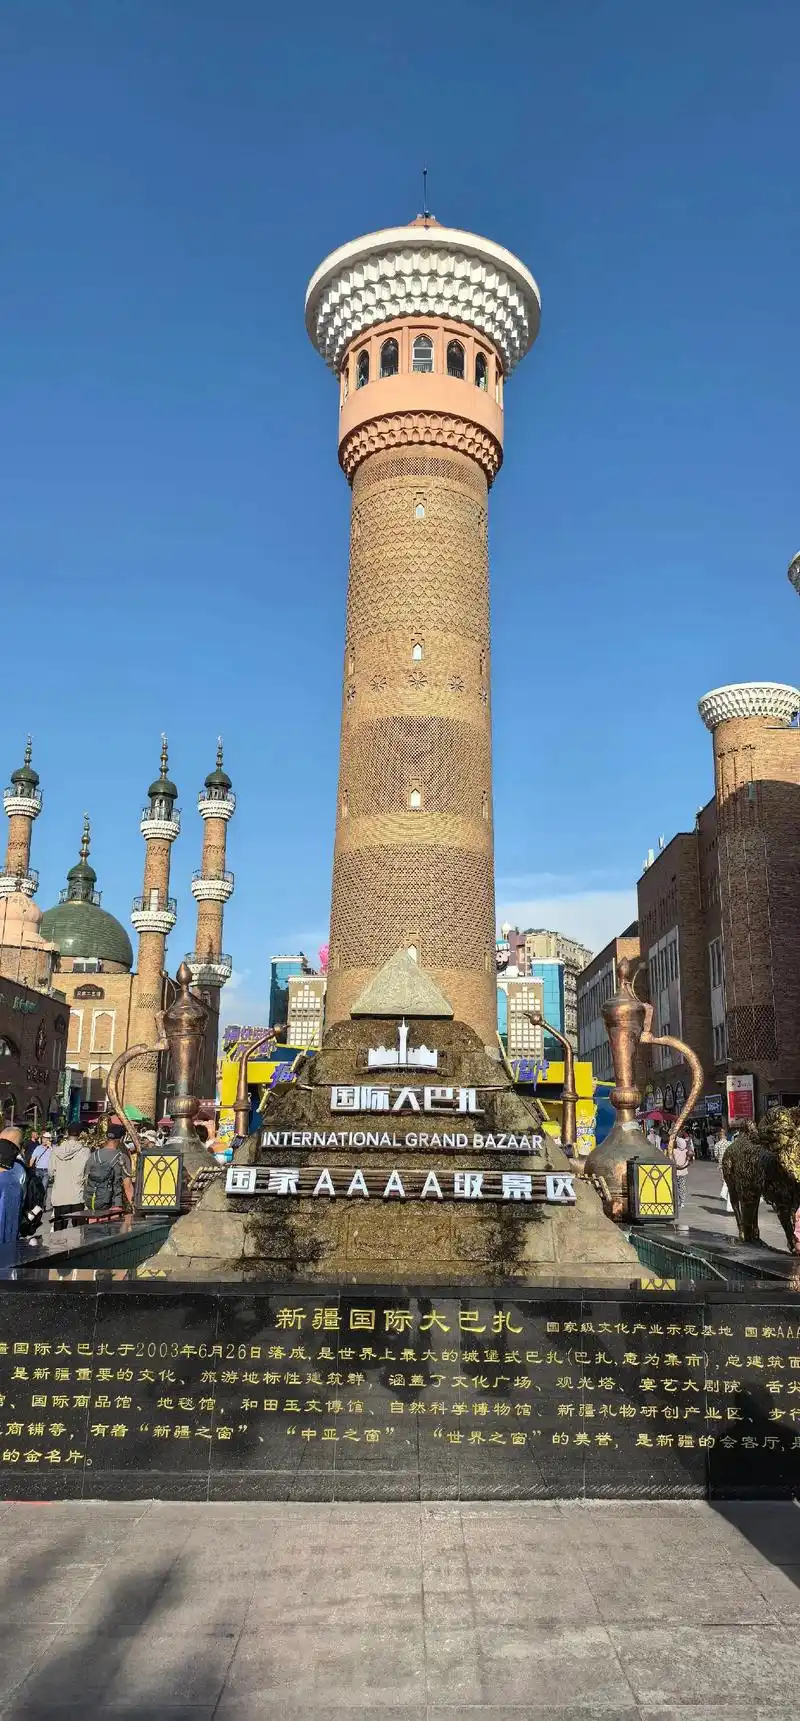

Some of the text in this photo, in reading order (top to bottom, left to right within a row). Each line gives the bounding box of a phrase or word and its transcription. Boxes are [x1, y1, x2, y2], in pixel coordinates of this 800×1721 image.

[330, 1086, 485, 1113] 国际大巴扎
[262, 1131, 544, 1150] INTERNATIONAL GRAND BAZAAR
[275, 1307, 523, 1334] 新疆国际大巴扎
[2, 1449, 93, 1466] 的金名片。
